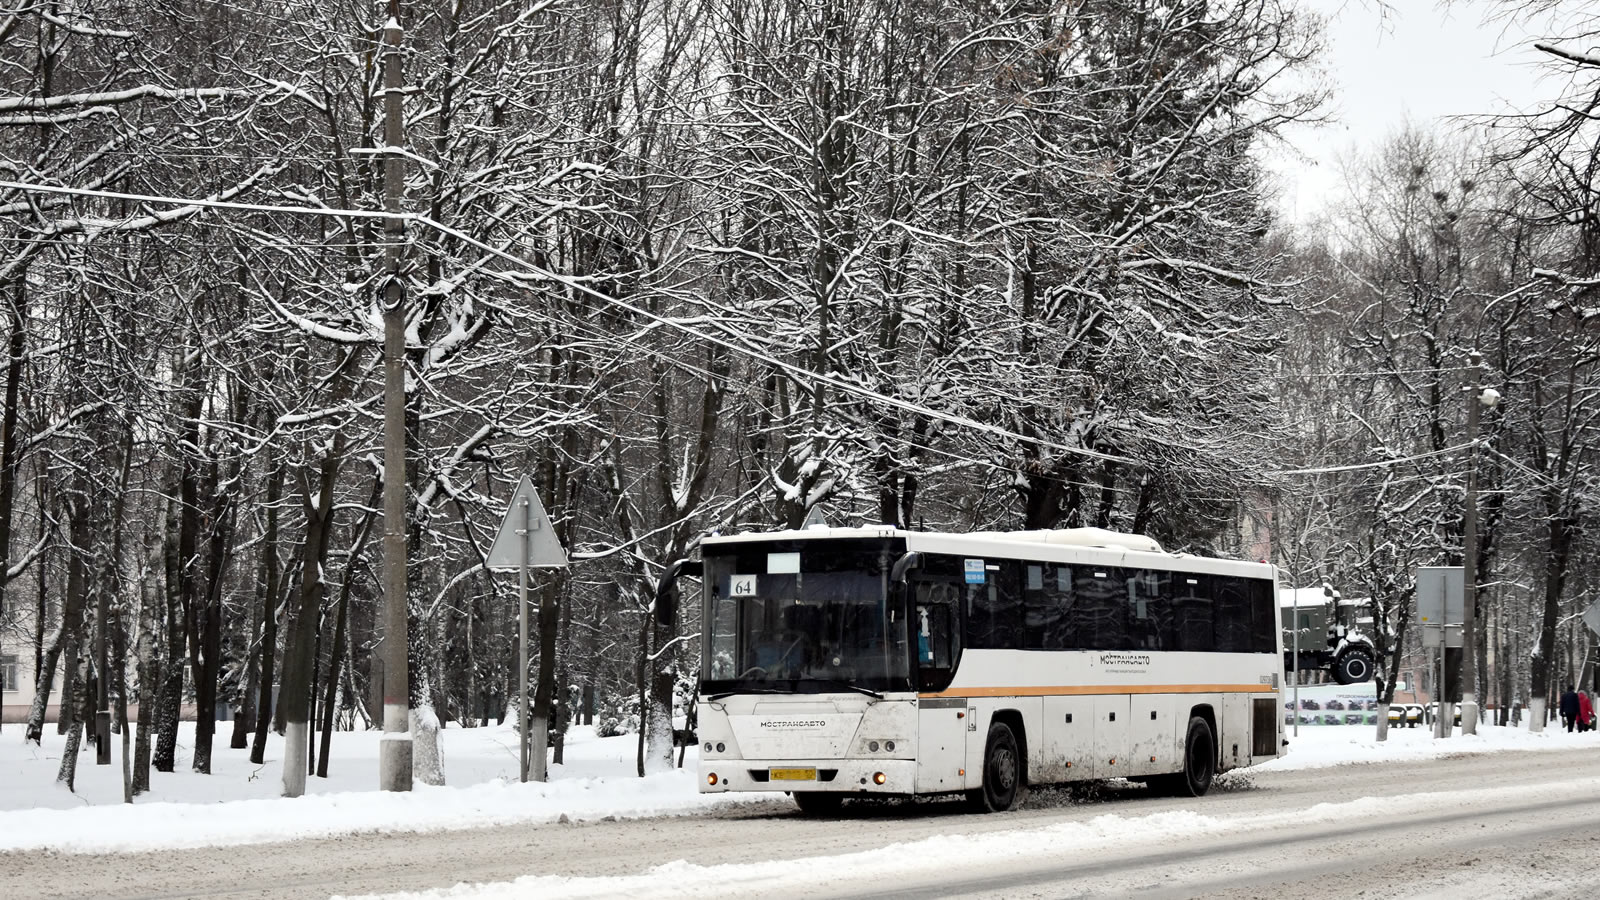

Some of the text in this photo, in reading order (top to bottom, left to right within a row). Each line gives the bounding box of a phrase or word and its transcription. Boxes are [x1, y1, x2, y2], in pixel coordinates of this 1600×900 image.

[735, 580, 751, 594] 64
[1099, 655, 1150, 665] МОСТРАНСАВТО
[760, 720, 826, 728] МОСТРАНСАВТО
